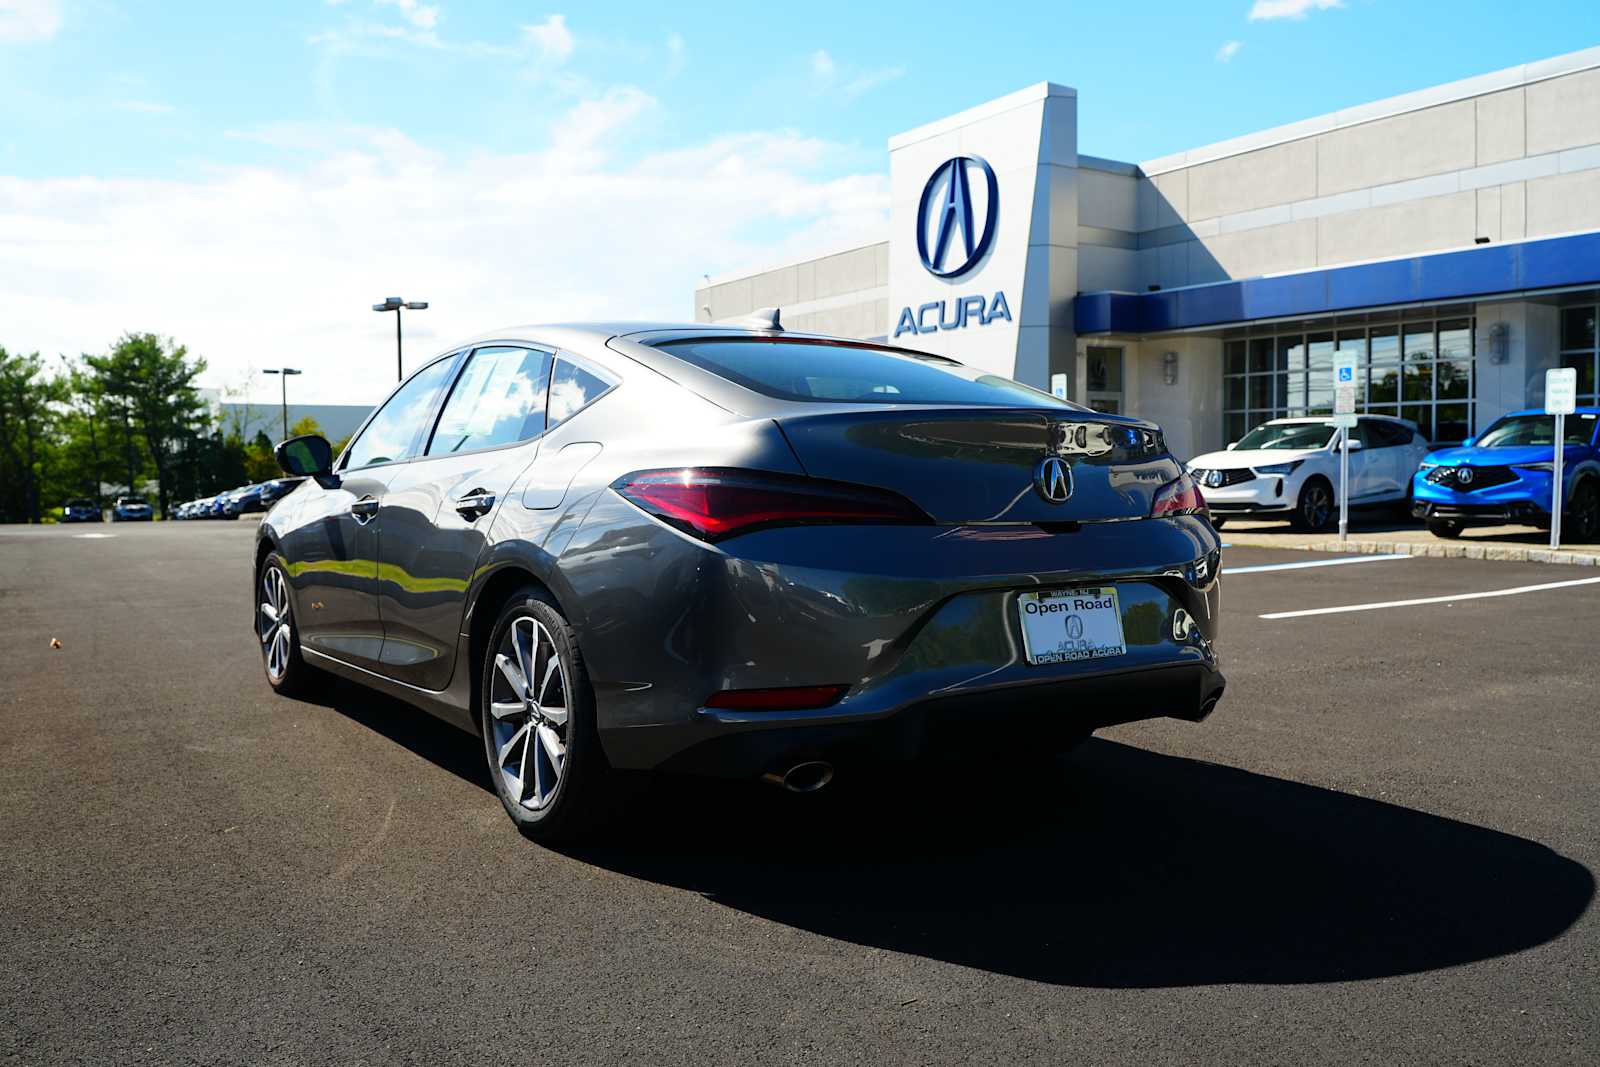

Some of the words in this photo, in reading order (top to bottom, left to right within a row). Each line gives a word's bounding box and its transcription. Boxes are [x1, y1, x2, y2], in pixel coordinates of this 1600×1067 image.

[894, 291, 1012, 338] ACURA
[1025, 602, 1068, 616] Open
[1074, 598, 1113, 611] Road
[1038, 652, 1063, 664] OPEN
[1065, 650, 1090, 661] ROAD
[1093, 647, 1121, 658] ACURA
